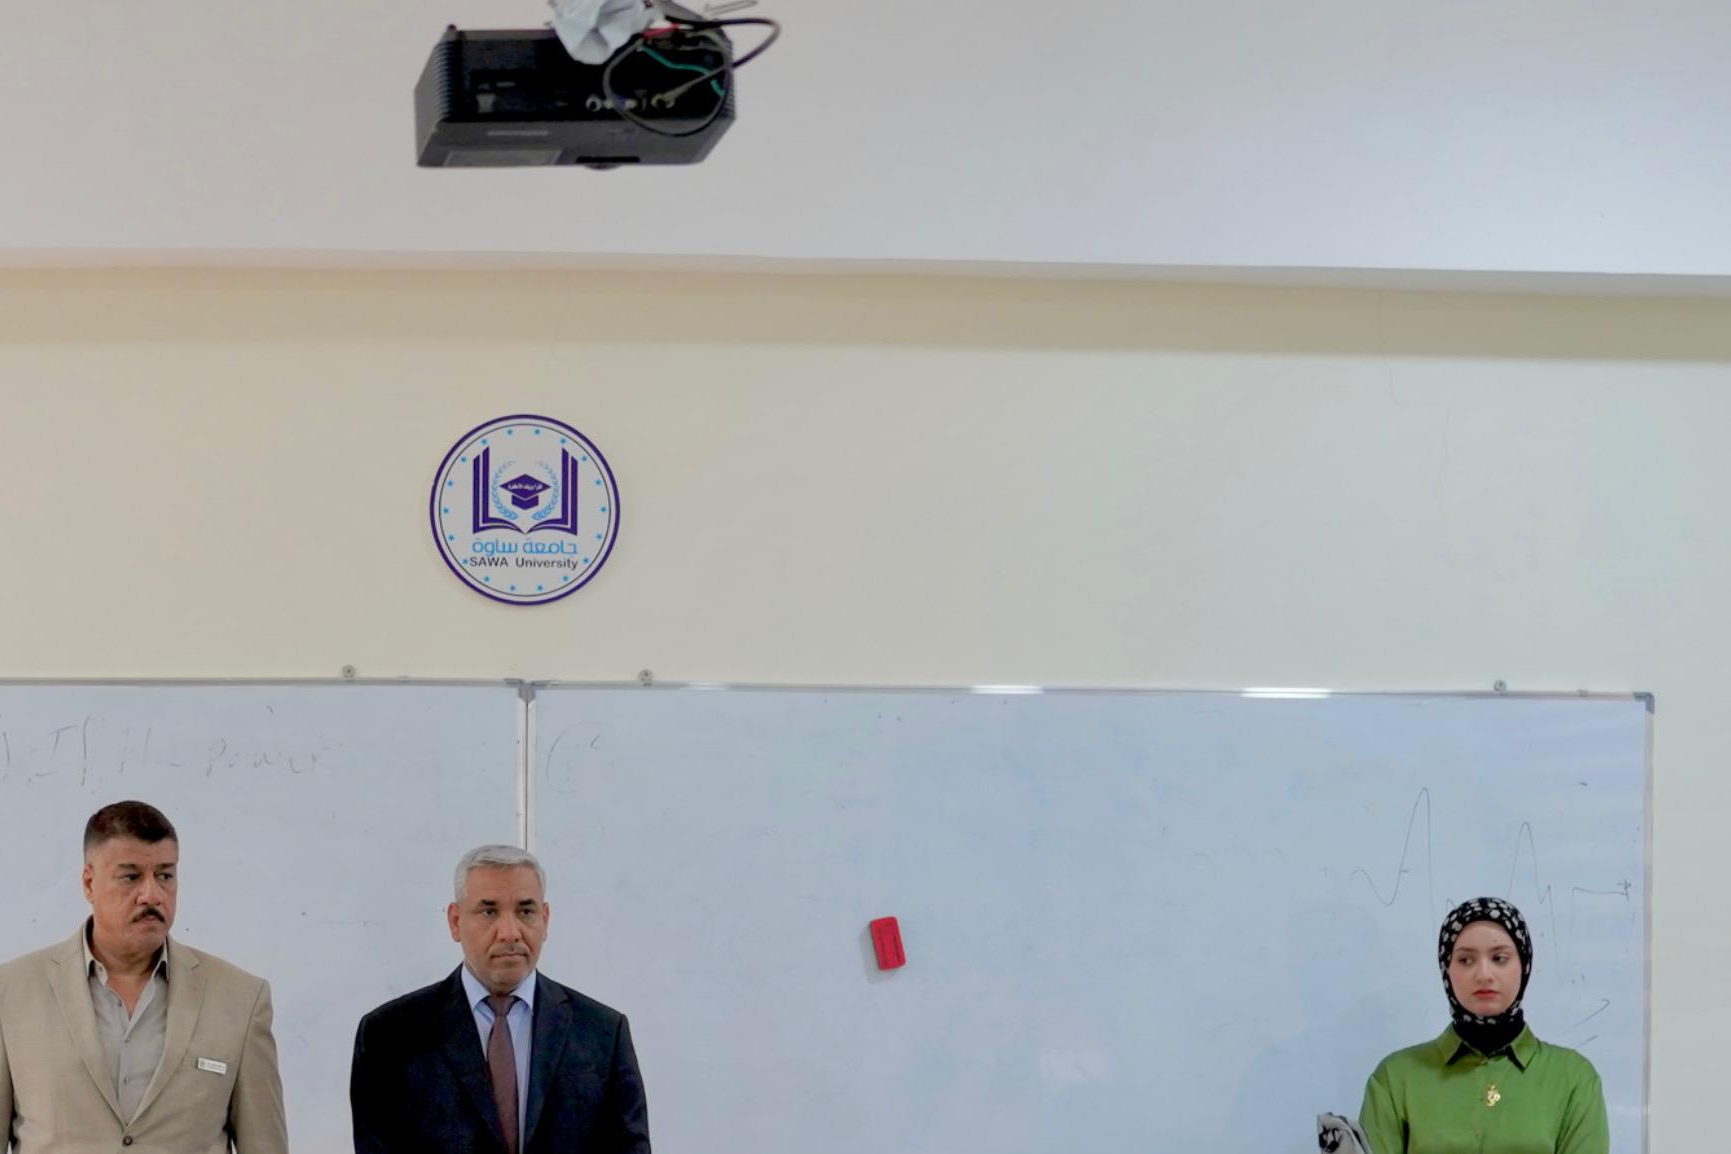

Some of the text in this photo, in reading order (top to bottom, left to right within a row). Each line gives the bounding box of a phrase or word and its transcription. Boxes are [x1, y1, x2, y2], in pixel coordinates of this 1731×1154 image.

[472, 537, 578, 556] جامعة ساوة
[469, 556, 578, 571] SAWA University
